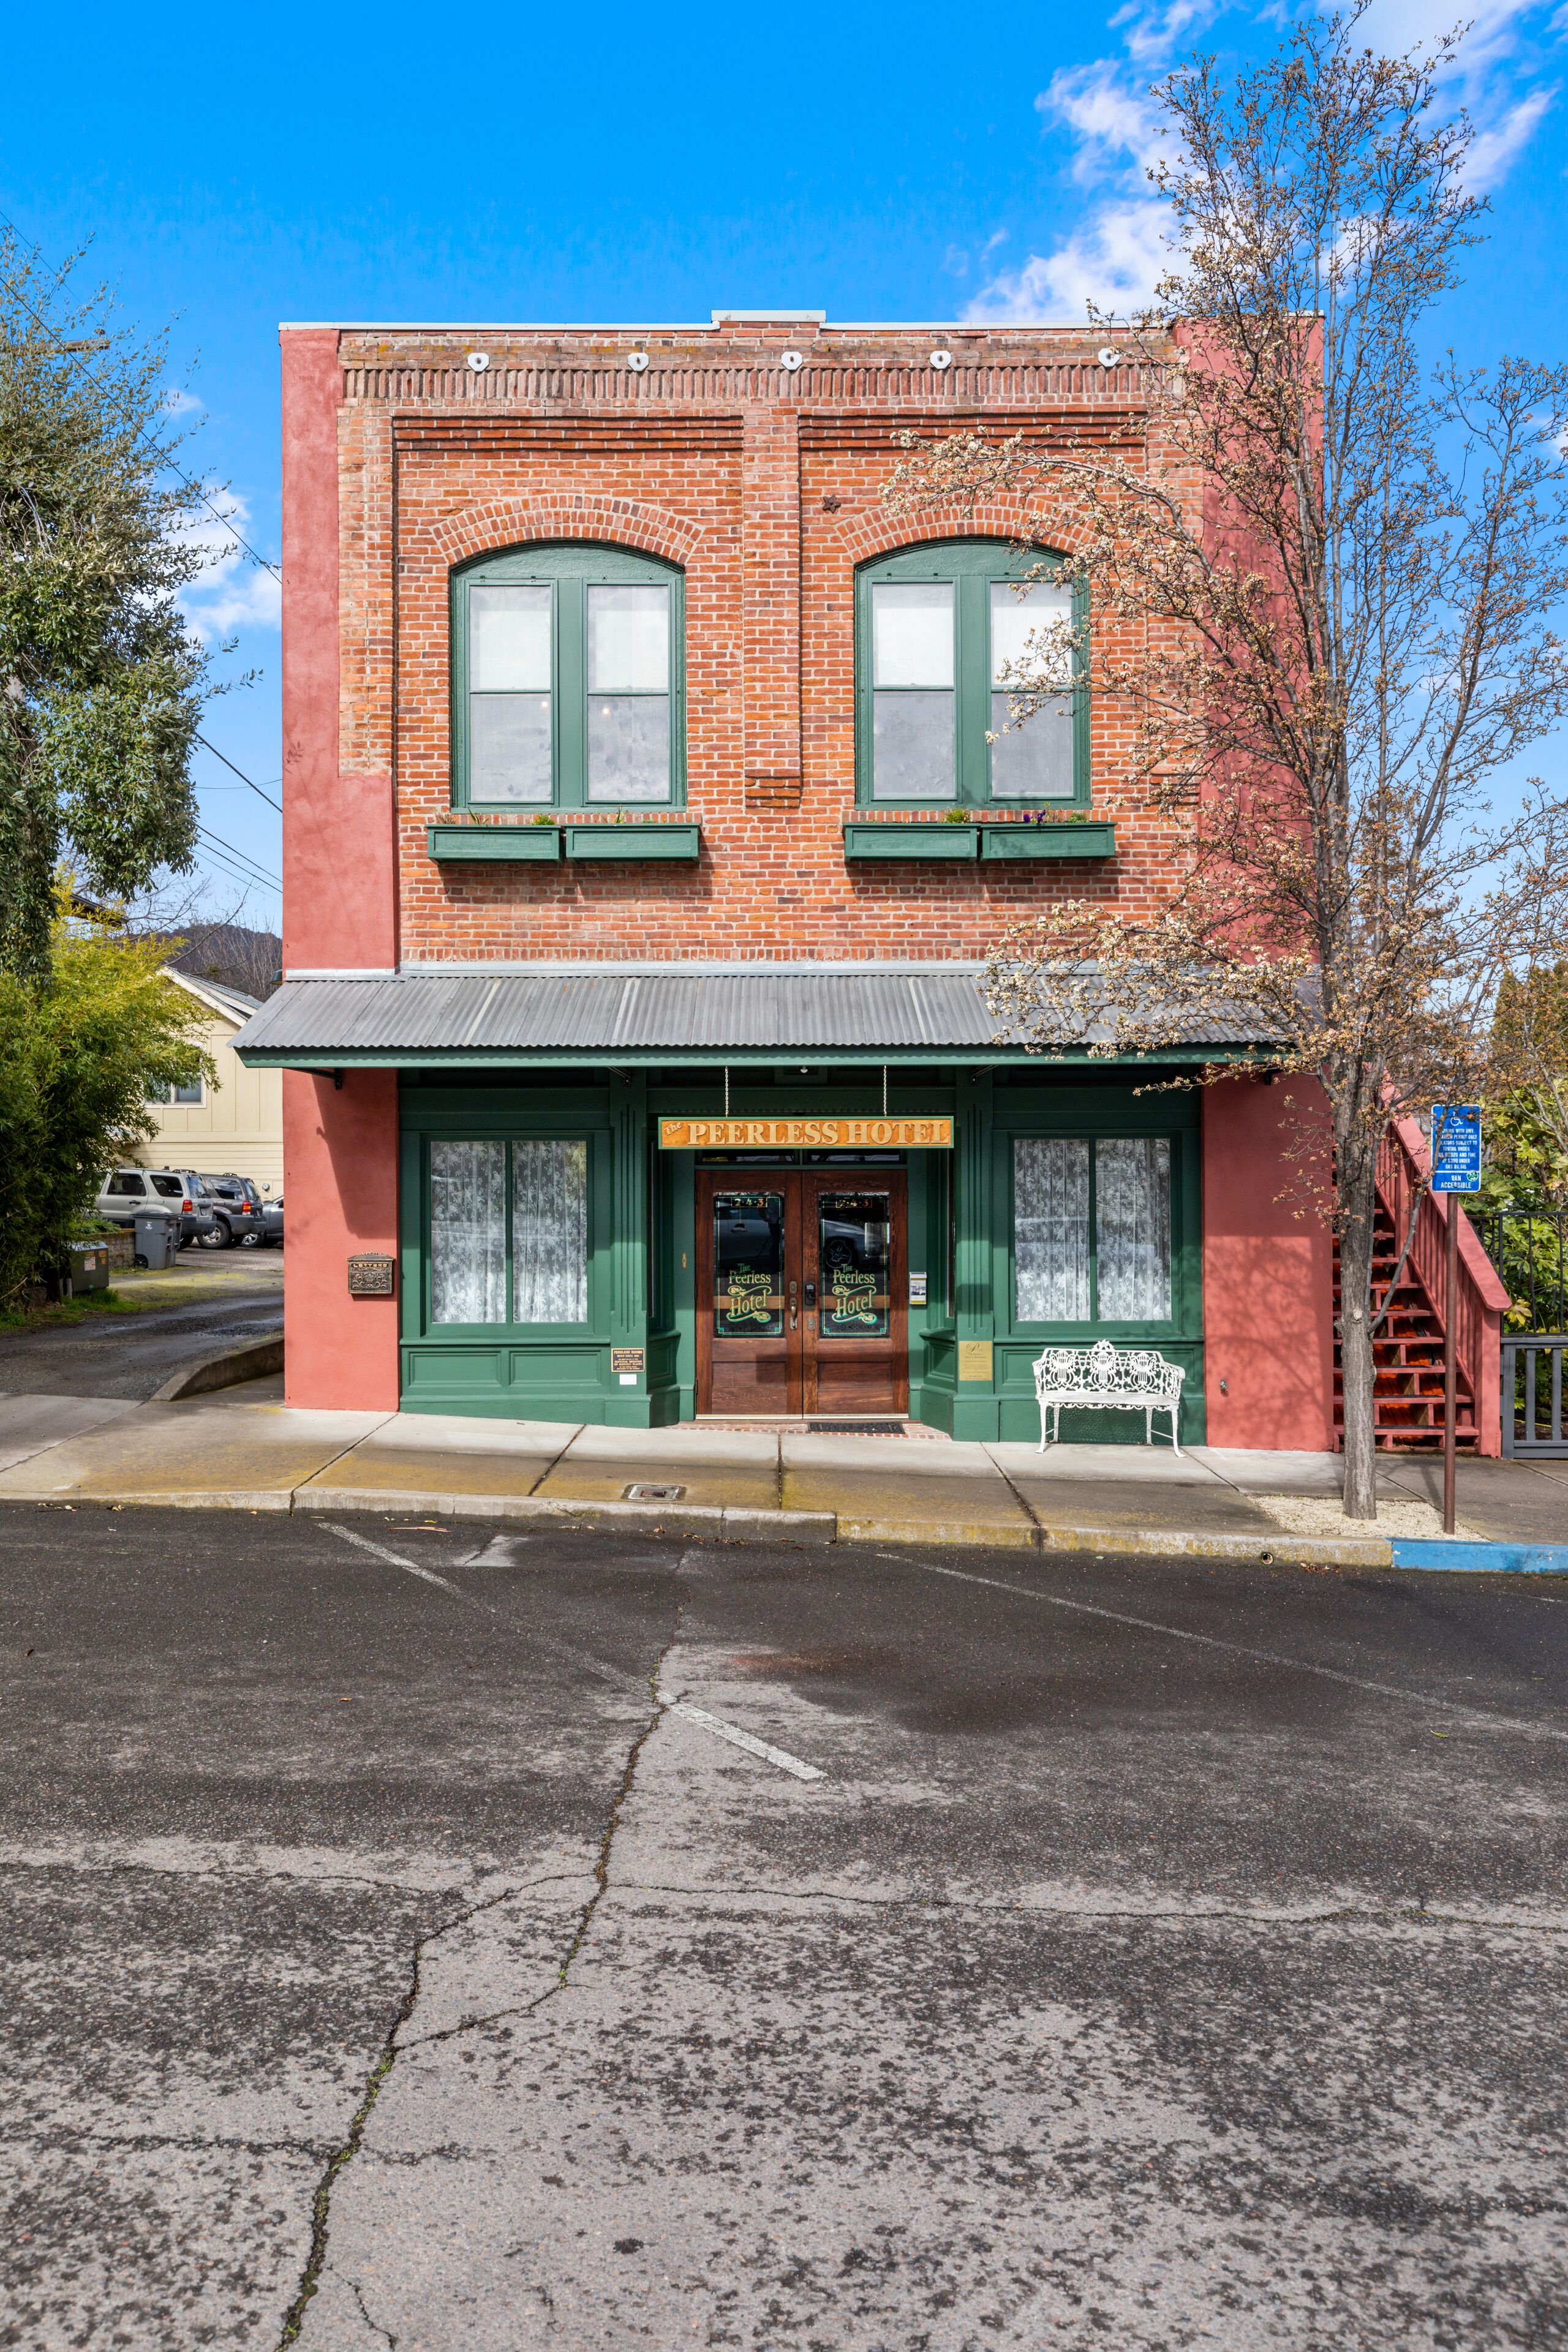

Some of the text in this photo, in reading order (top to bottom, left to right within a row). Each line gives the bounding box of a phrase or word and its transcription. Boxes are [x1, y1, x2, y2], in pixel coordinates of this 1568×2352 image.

[664, 1121, 949, 1145] The PEERLESS HOTEL
[729, 1270, 771, 1284] Peerless
[833, 1269, 876, 1284] Peerless
[730, 1289, 767, 1318] Hotel
[835, 1289, 873, 1318] Hotel
